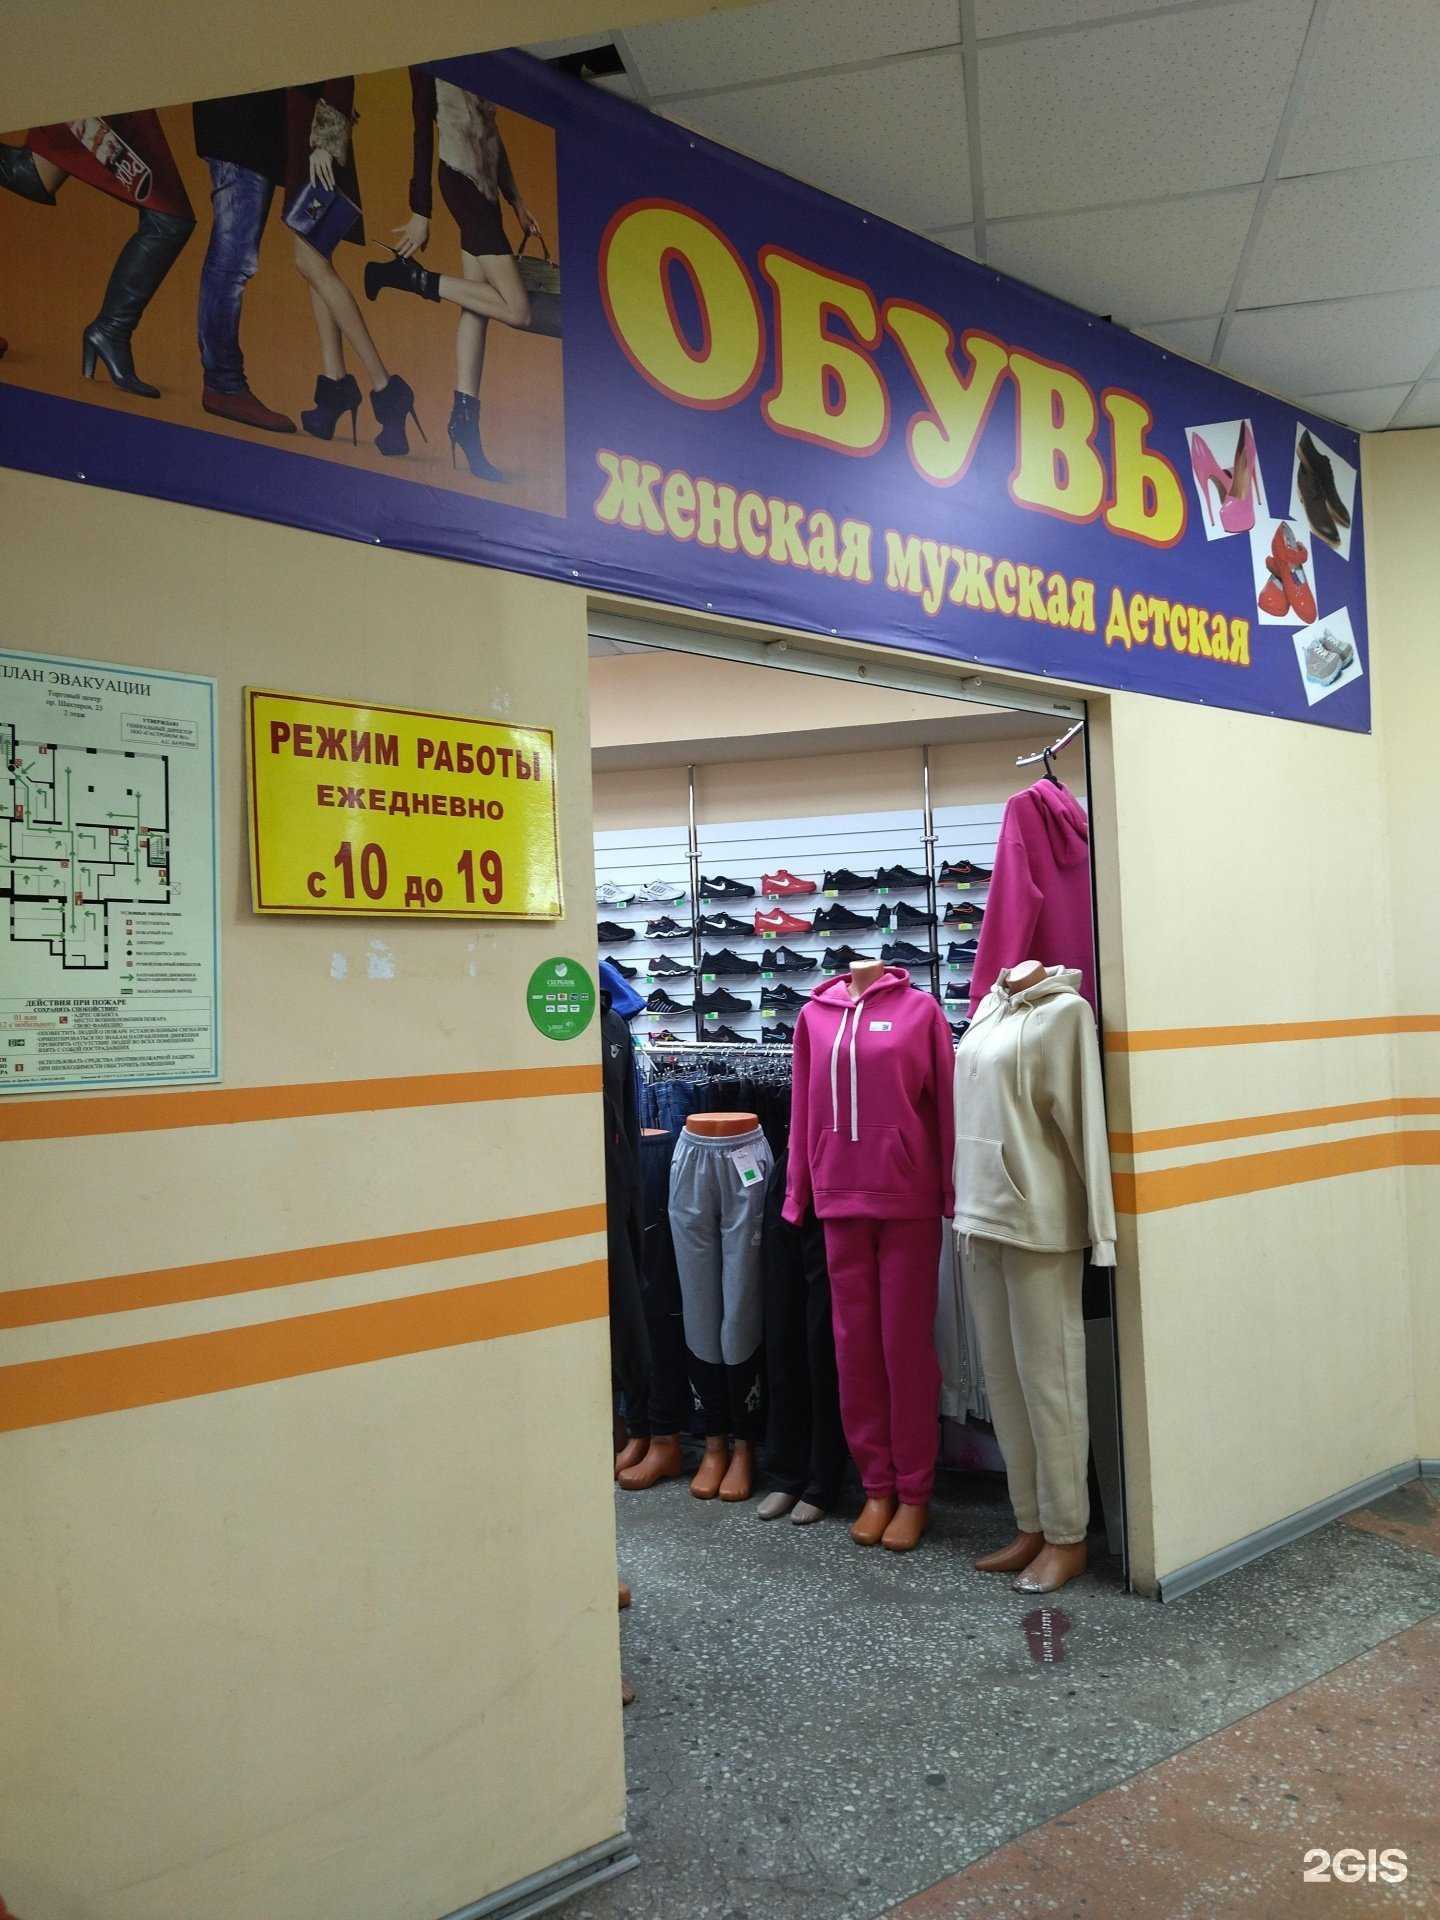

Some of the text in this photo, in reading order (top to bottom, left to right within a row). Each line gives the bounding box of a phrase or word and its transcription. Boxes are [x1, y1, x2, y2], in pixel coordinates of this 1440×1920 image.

[598, 197, 1188, 548] ОБУВЬ
[48, 671, 151, 697] ЭВАКУАЦИИ
[270, 720, 541, 781] РЕЖИМ РАБОТЫ
[317, 784, 504, 821] ЕЖЕДНЕВНО
[334, 841, 388, 900] 10
[404, 875, 443, 908] до
[457, 849, 503, 905] 19
